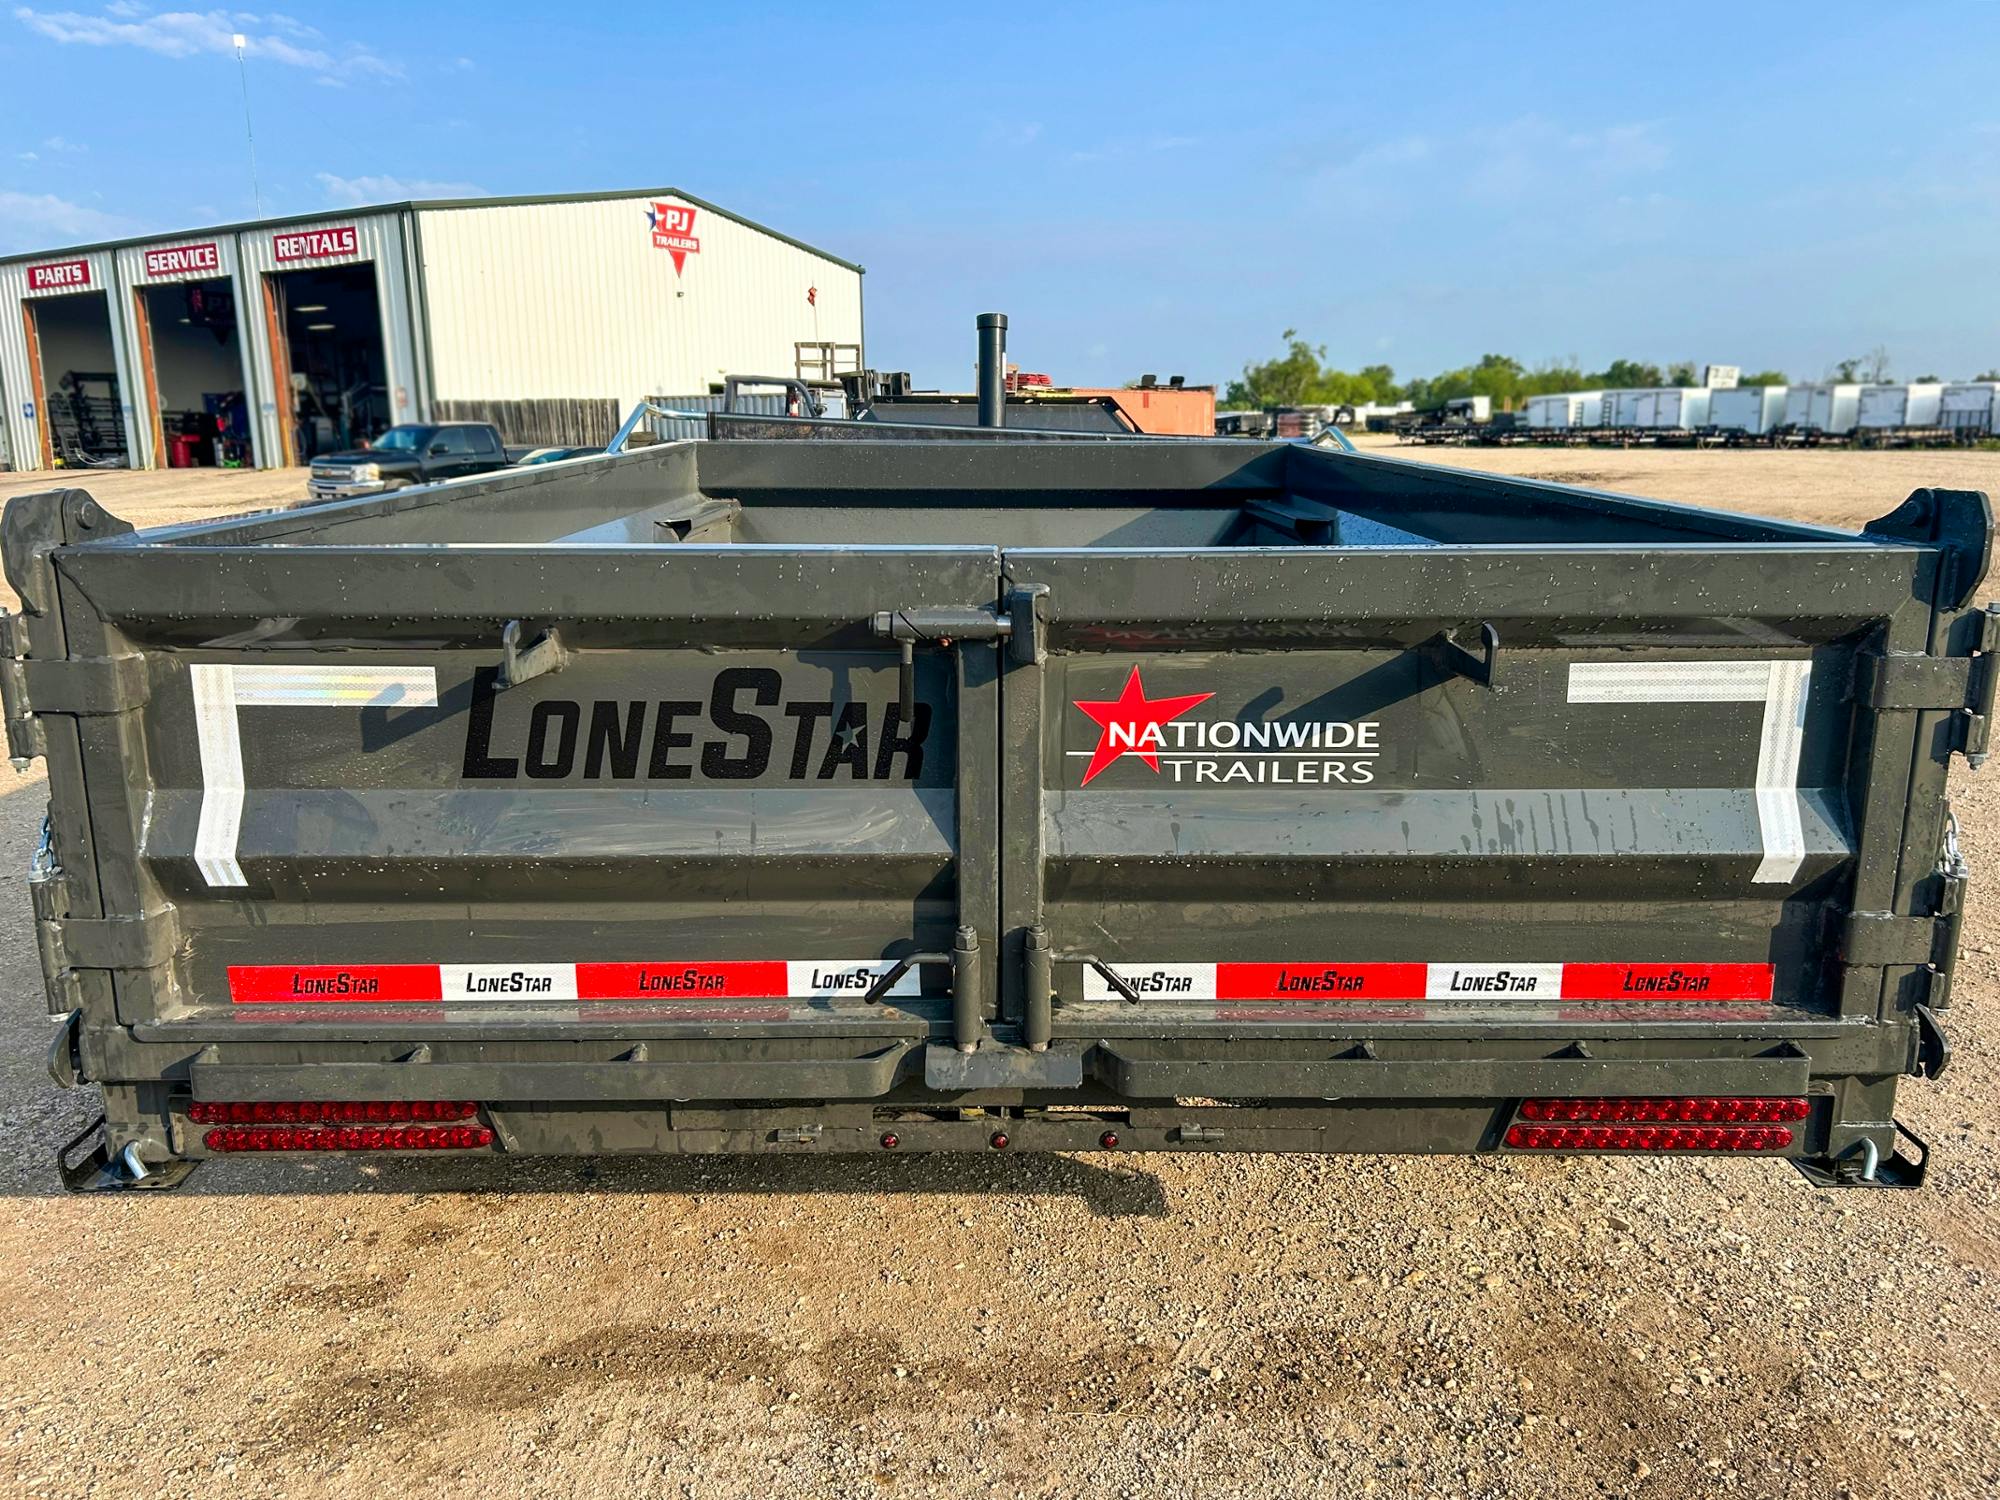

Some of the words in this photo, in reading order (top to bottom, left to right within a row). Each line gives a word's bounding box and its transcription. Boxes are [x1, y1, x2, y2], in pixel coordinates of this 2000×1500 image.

[666, 209, 689, 231] PJ
[276, 230, 355, 258] RENTALS
[655, 235, 698, 249] TRAILERS
[147, 246, 217, 272] SERVICE
[34, 263, 83, 285] PARTS
[461, 665, 934, 780] LONESTAR
[1108, 721, 1380, 748] NATIONWIDE
[1162, 760, 1375, 784] TRAILERS
[292, 973, 379, 994] LONESTAR
[466, 972, 552, 993] LONESTAR
[639, 970, 725, 991] LONESTAR
[811, 968, 895, 990] LONEST
[1107, 971, 1193, 993] NESTAR
[1277, 970, 1364, 992] LONESTAR
[1450, 970, 1537, 992] LONESTAR
[1623, 970, 1710, 992] LONESTAR
